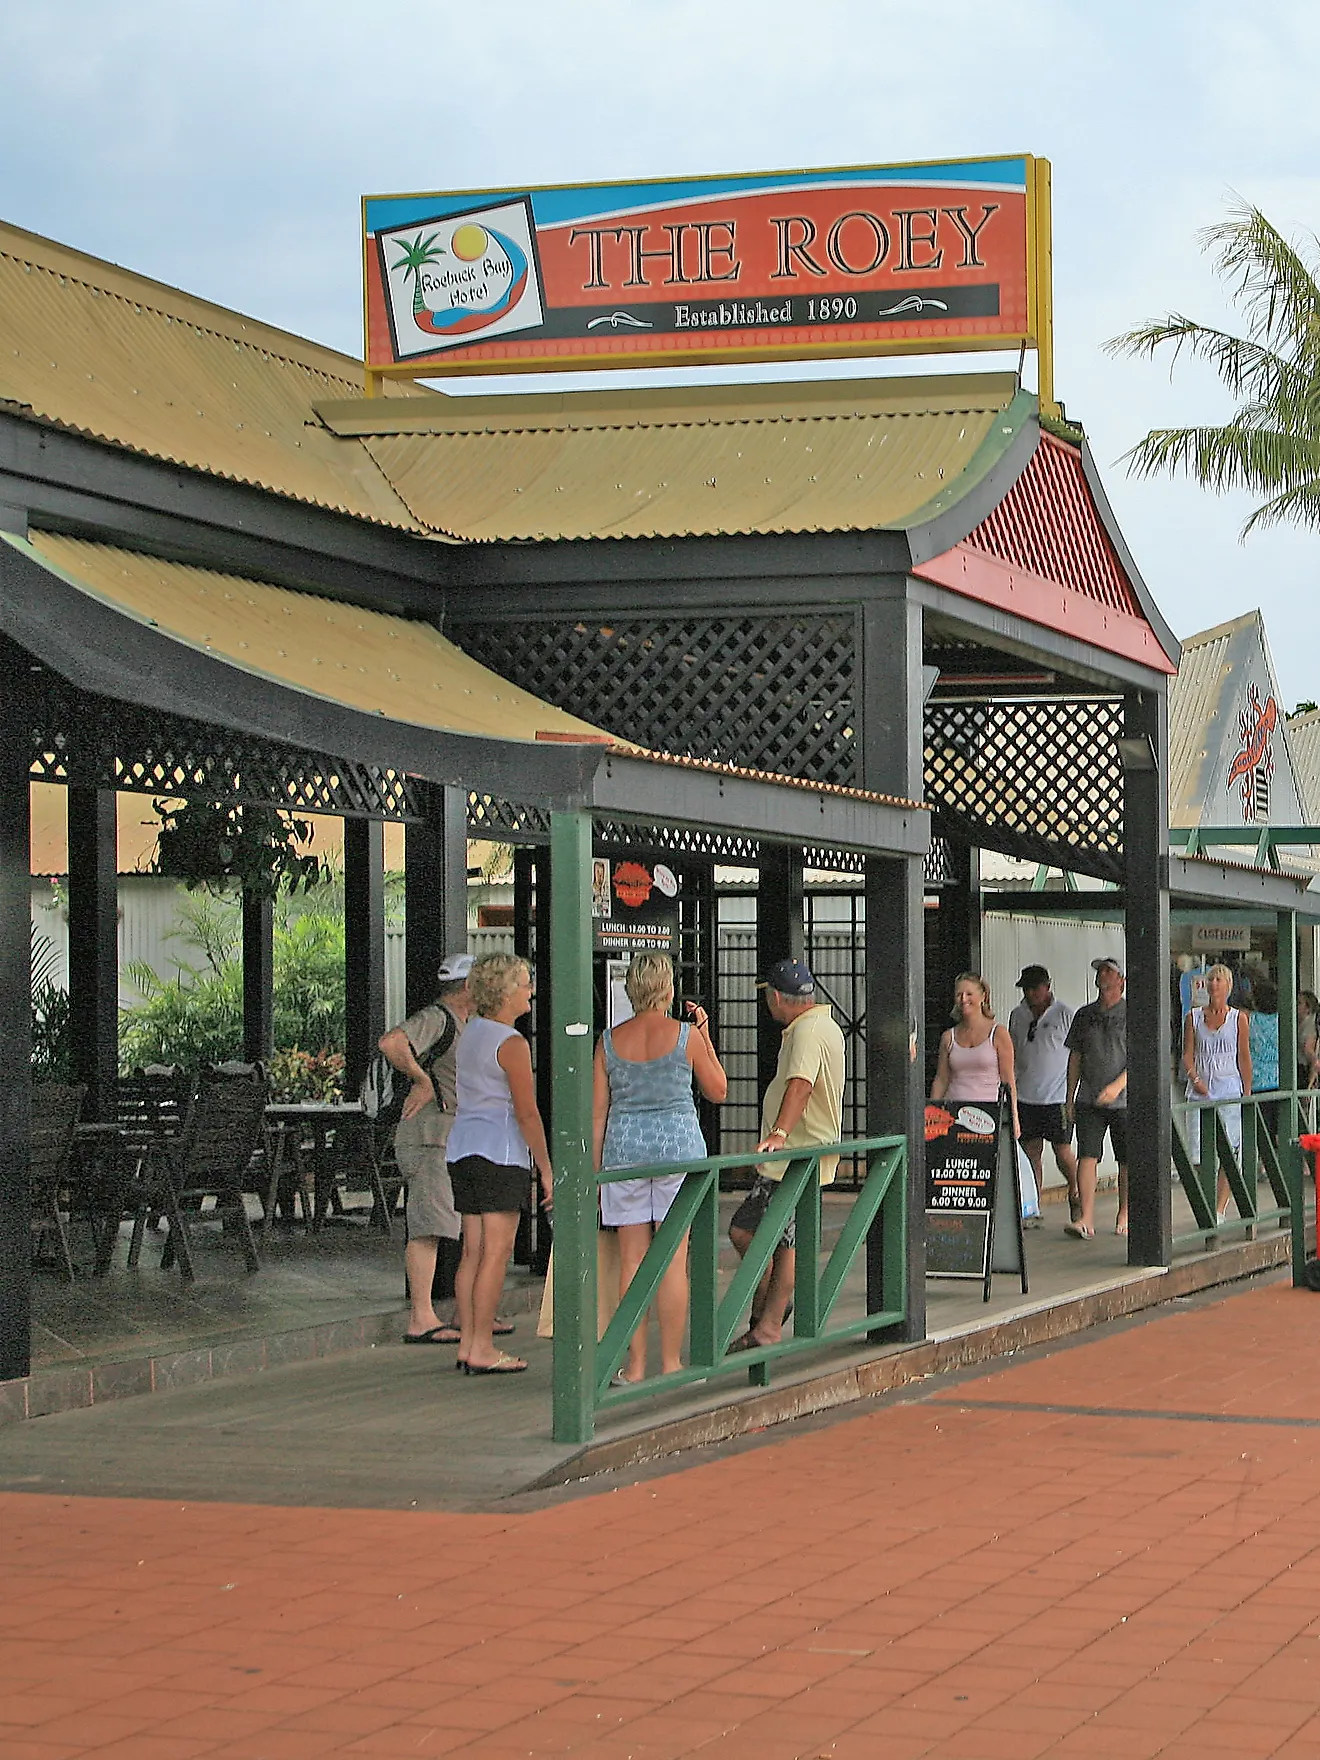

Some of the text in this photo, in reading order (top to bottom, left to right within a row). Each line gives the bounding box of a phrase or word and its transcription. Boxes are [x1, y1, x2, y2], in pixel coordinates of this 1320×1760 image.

[568, 204, 1000, 290] THE ROEY
[421, 258, 510, 294] Roebuck Bay
[448, 282, 489, 308] Hotel
[673, 296, 858, 329] Established 1890
[602, 922, 626, 933] LUNCH
[646, 924, 657, 936] TO
[603, 937, 629, 947] DINNER
[646, 938, 657, 950] TO
[945, 1158, 978, 1170] LUNCH
[931, 1168, 955, 1180] 12.00
[956, 1168, 970, 1180] TO
[941, 1186, 978, 1198] DINNER
[931, 1196, 987, 1208] 6.00 TO 9.00
